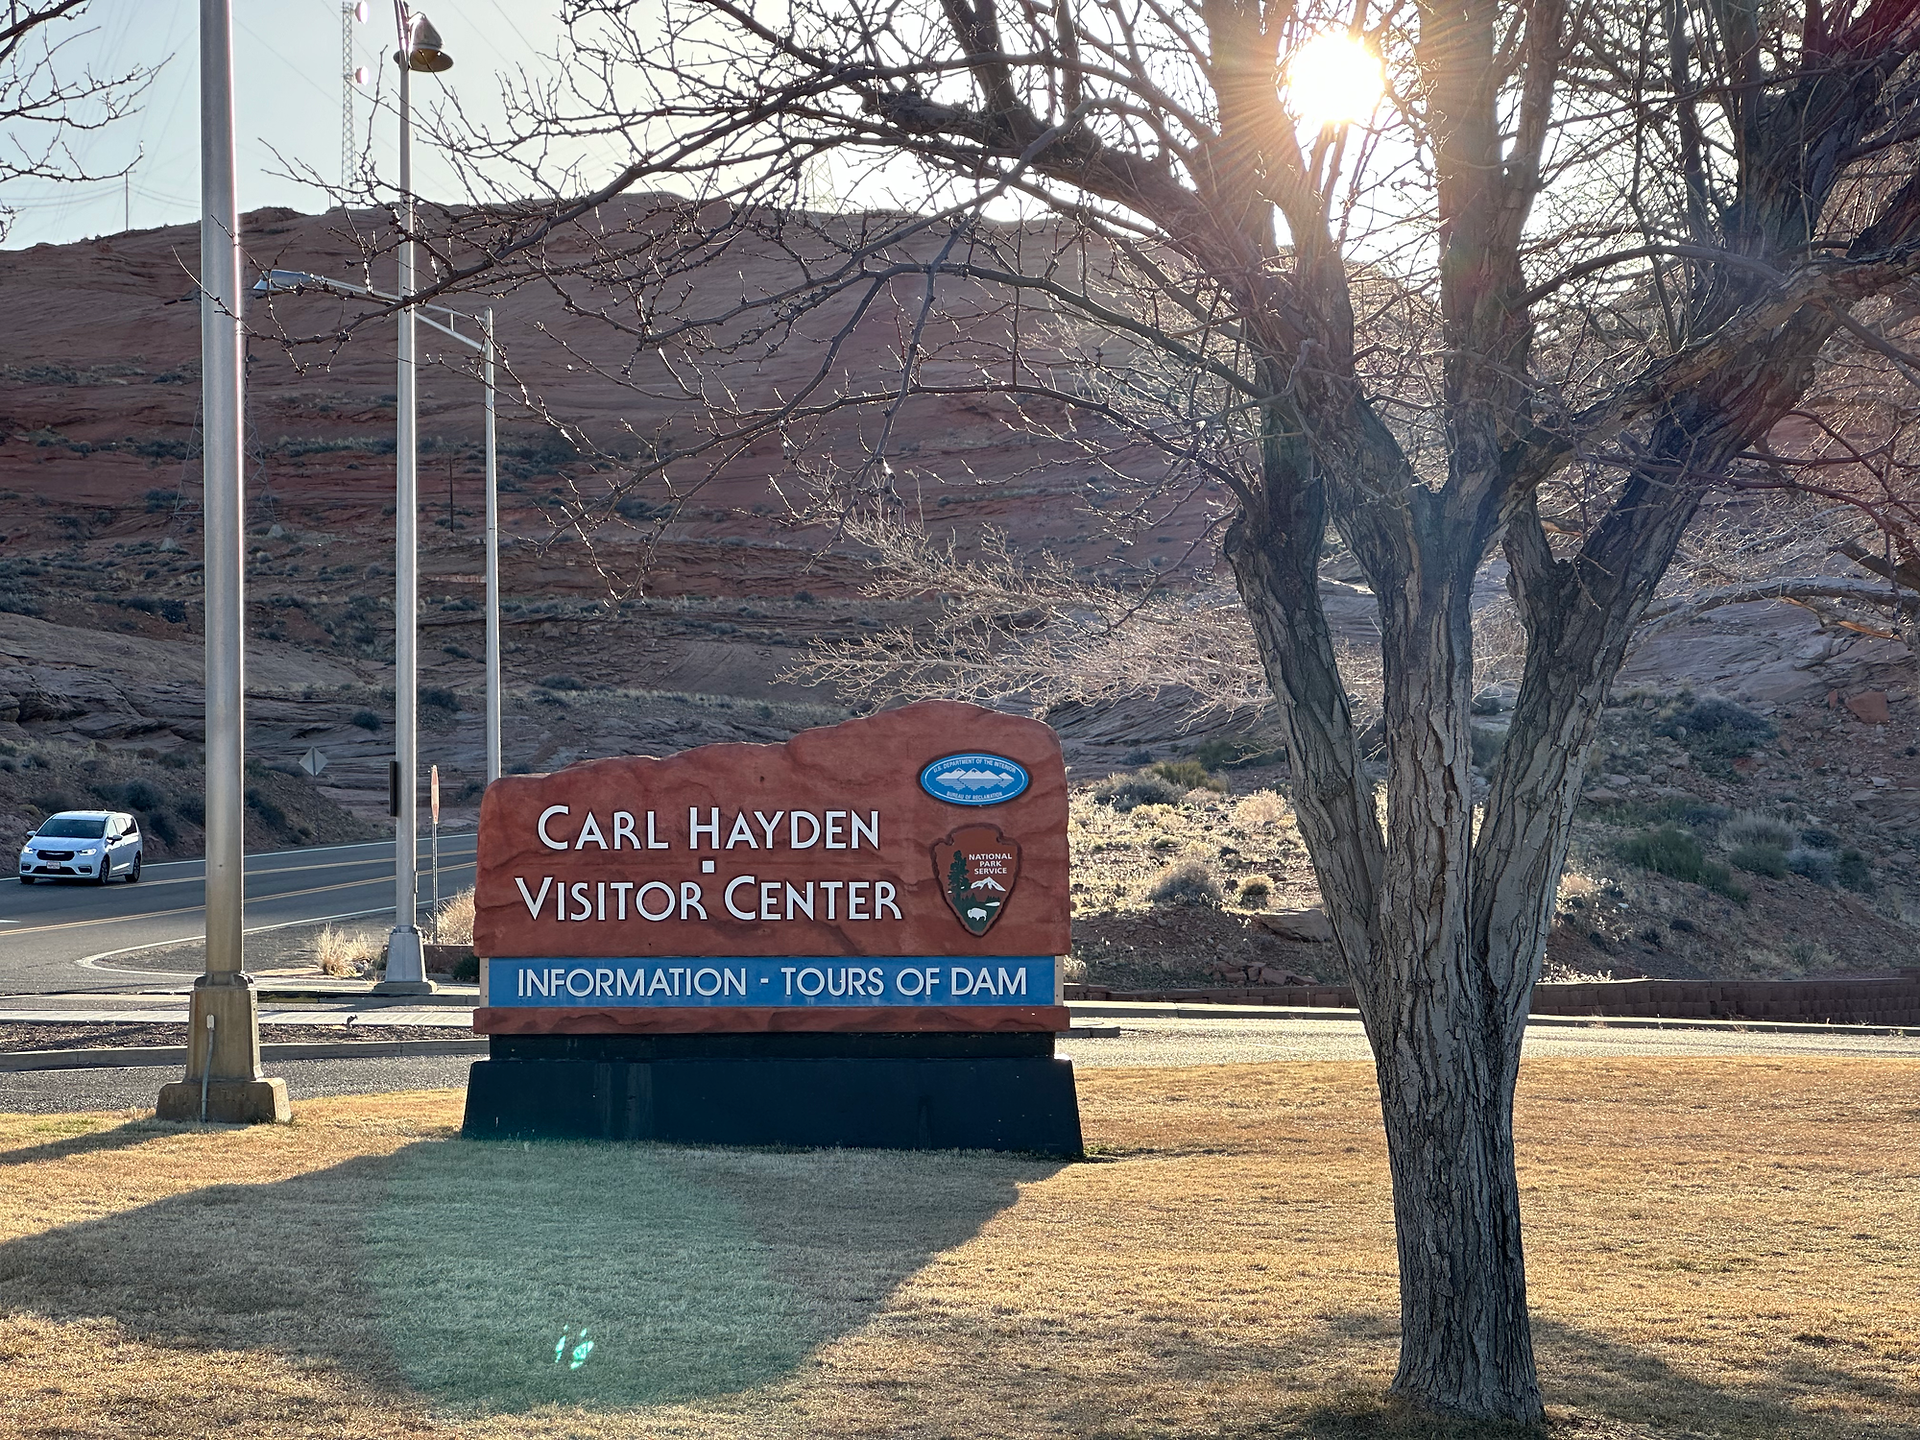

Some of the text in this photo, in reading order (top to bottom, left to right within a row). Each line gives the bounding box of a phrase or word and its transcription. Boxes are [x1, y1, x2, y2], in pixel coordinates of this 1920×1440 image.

[933, 765, 942, 773] U.S.
[943, 758, 975, 769] DEPARTMENT
[983, 758, 994, 766] THE
[994, 761, 1016, 773] INTERIOR
[946, 791, 965, 799] BUREAU
[972, 791, 1003, 800] RECLAMATION
[537, 803, 880, 850] CARL HAYDEN
[974, 867, 1007, 875] SERVICE
[515, 875, 903, 921] VISITOR CENTER
[518, 967, 747, 997] INFORMATION
[781, 967, 884, 996] TOURS
[896, 967, 939, 996] OF
[950, 967, 1027, 996] DAM
